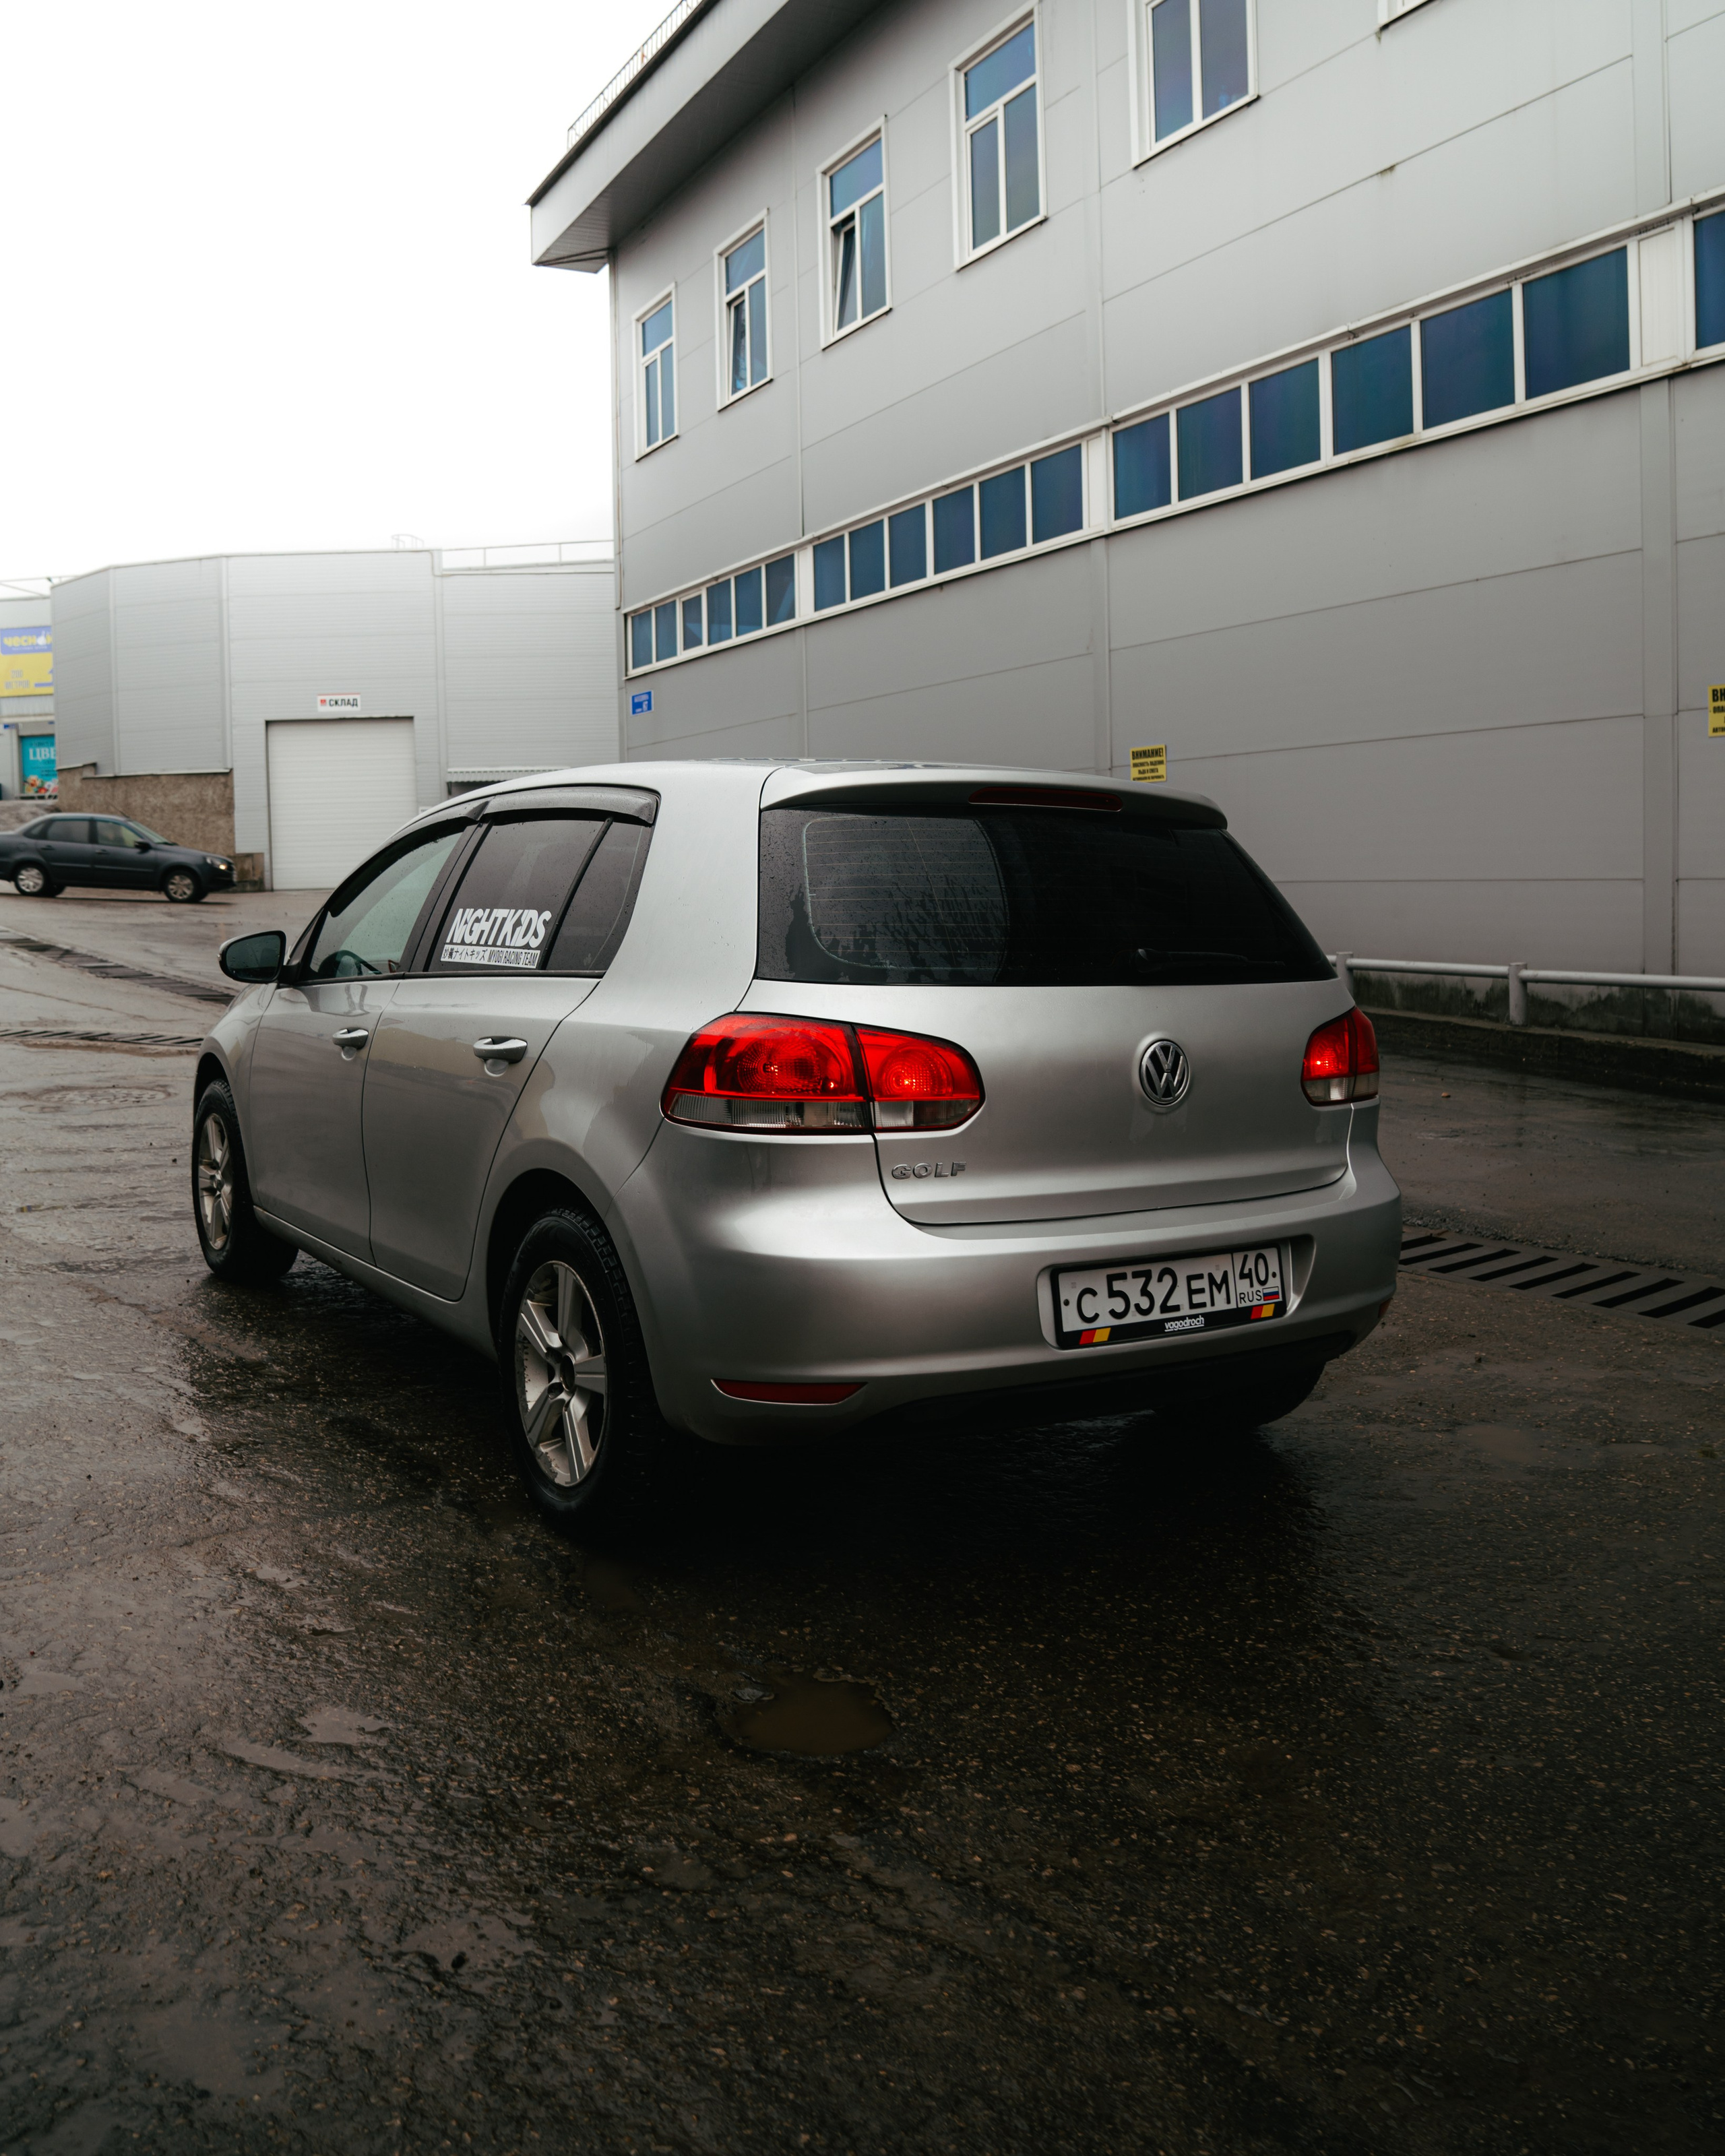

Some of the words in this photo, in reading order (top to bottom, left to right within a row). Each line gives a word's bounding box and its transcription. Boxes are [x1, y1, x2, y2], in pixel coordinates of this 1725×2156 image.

[329, 698, 358, 707] СКЛАД
[1132, 748, 1164, 760] ВНИМАНИЕ!
[487, 949, 505, 963] MYOGI
[503, 951, 523, 965] RACING
[522, 951, 538, 966] TEAM
[891, 1161, 966, 1180] GOLF
[1238, 1252, 1269, 1288] 40
[1239, 1290, 1263, 1304] RUS
[1164, 1314, 1205, 1332] vagodroch
